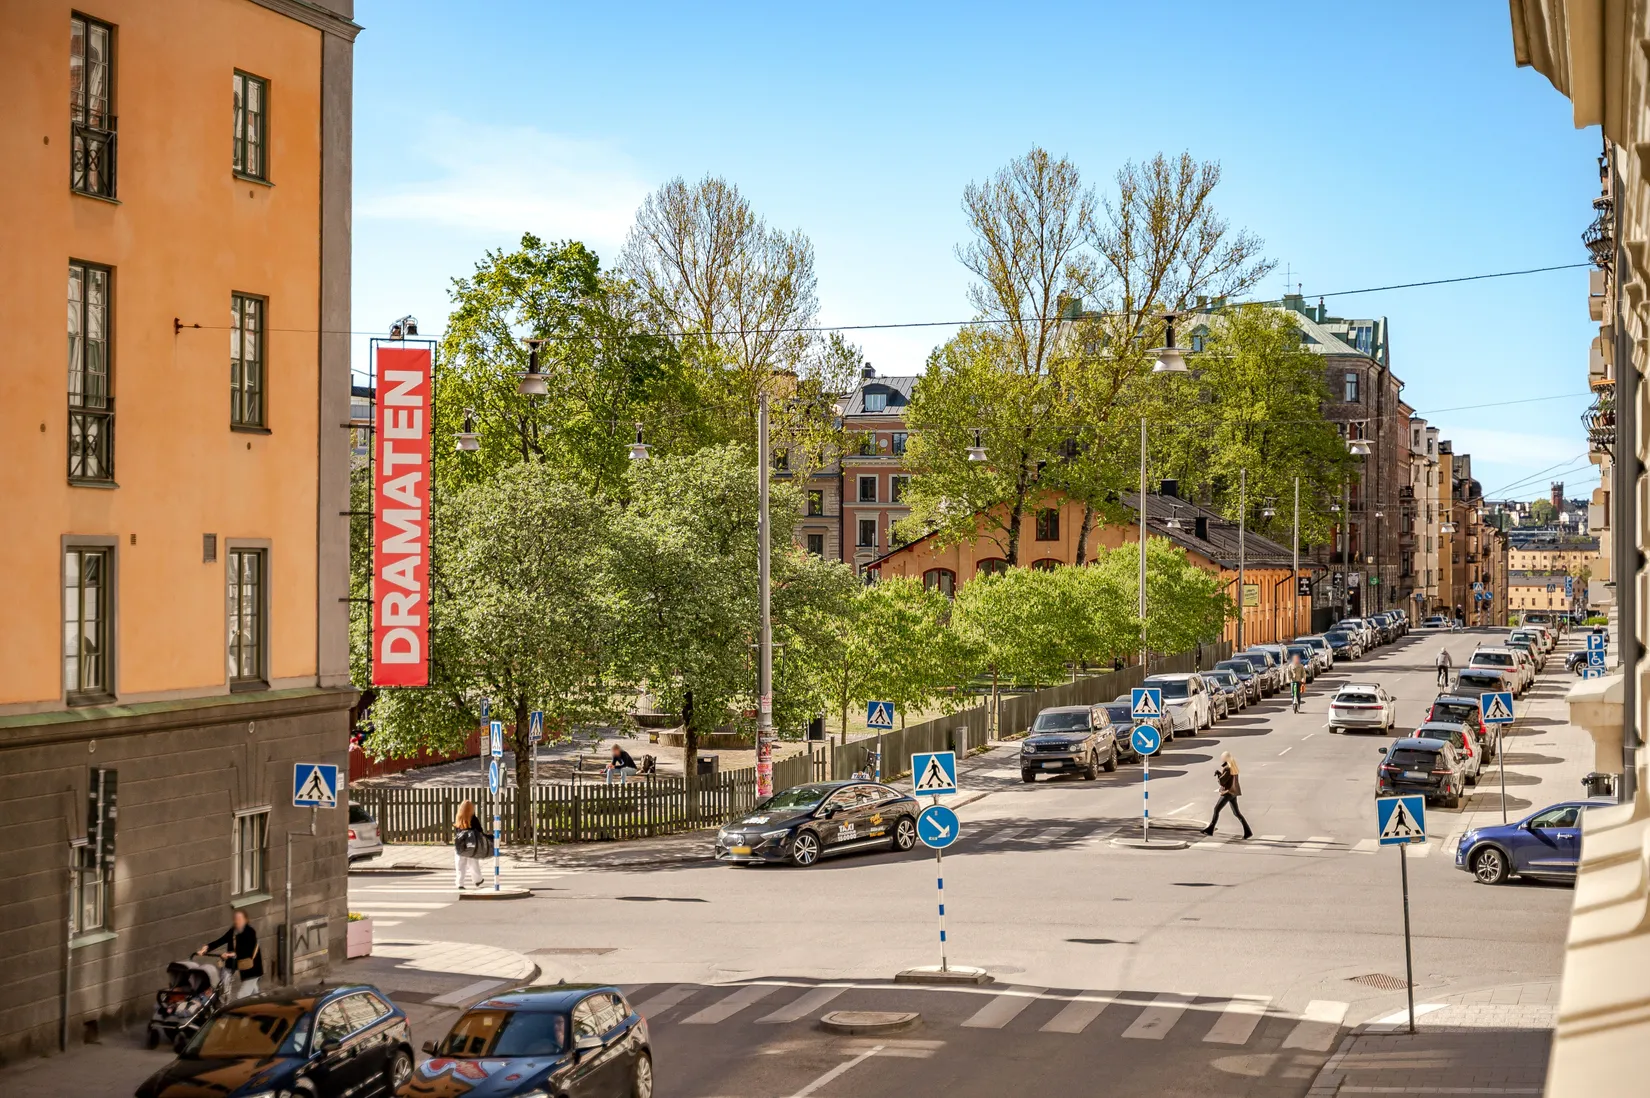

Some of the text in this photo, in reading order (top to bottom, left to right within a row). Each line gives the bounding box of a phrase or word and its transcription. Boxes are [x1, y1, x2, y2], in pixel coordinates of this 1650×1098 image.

[381, 370, 424, 665] DRAMATEN
[1591, 635, 1601, 650] P
[483, 700, 488, 715] P
